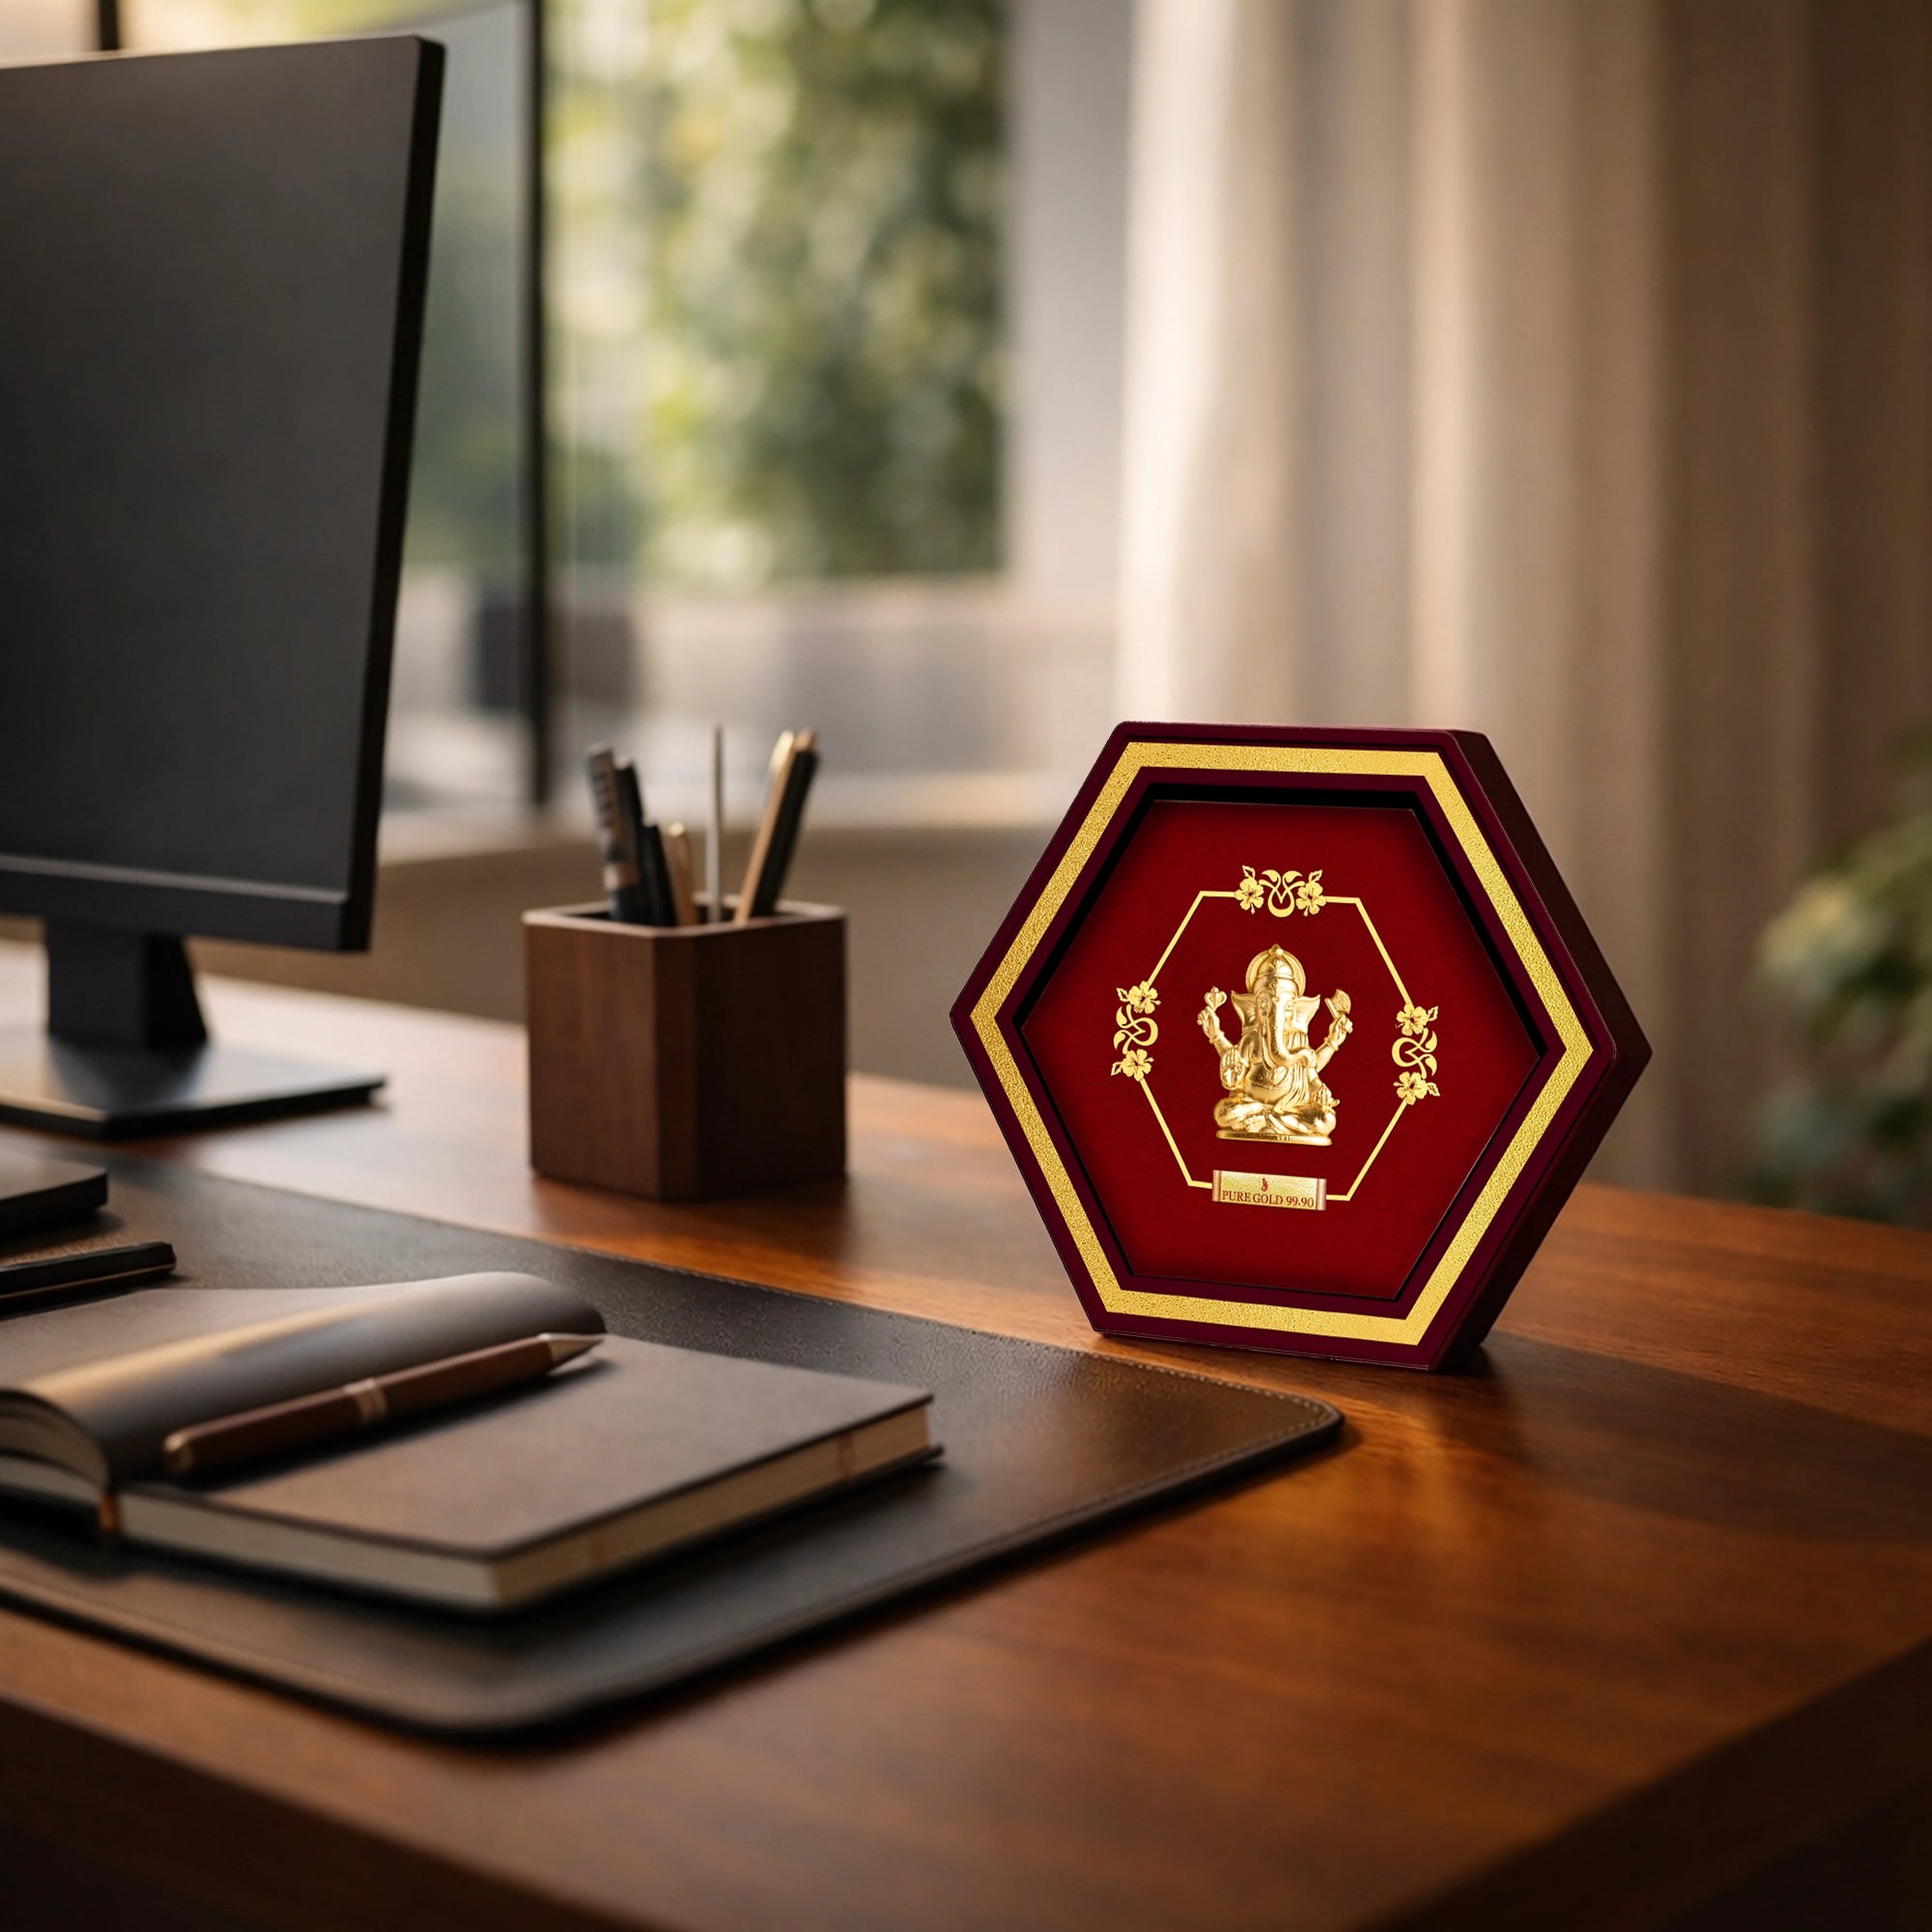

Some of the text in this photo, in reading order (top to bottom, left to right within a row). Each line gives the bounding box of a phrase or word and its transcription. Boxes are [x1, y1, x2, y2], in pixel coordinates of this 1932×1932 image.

[1222, 1190, 1314, 1208] PURE GOLD 99.90
